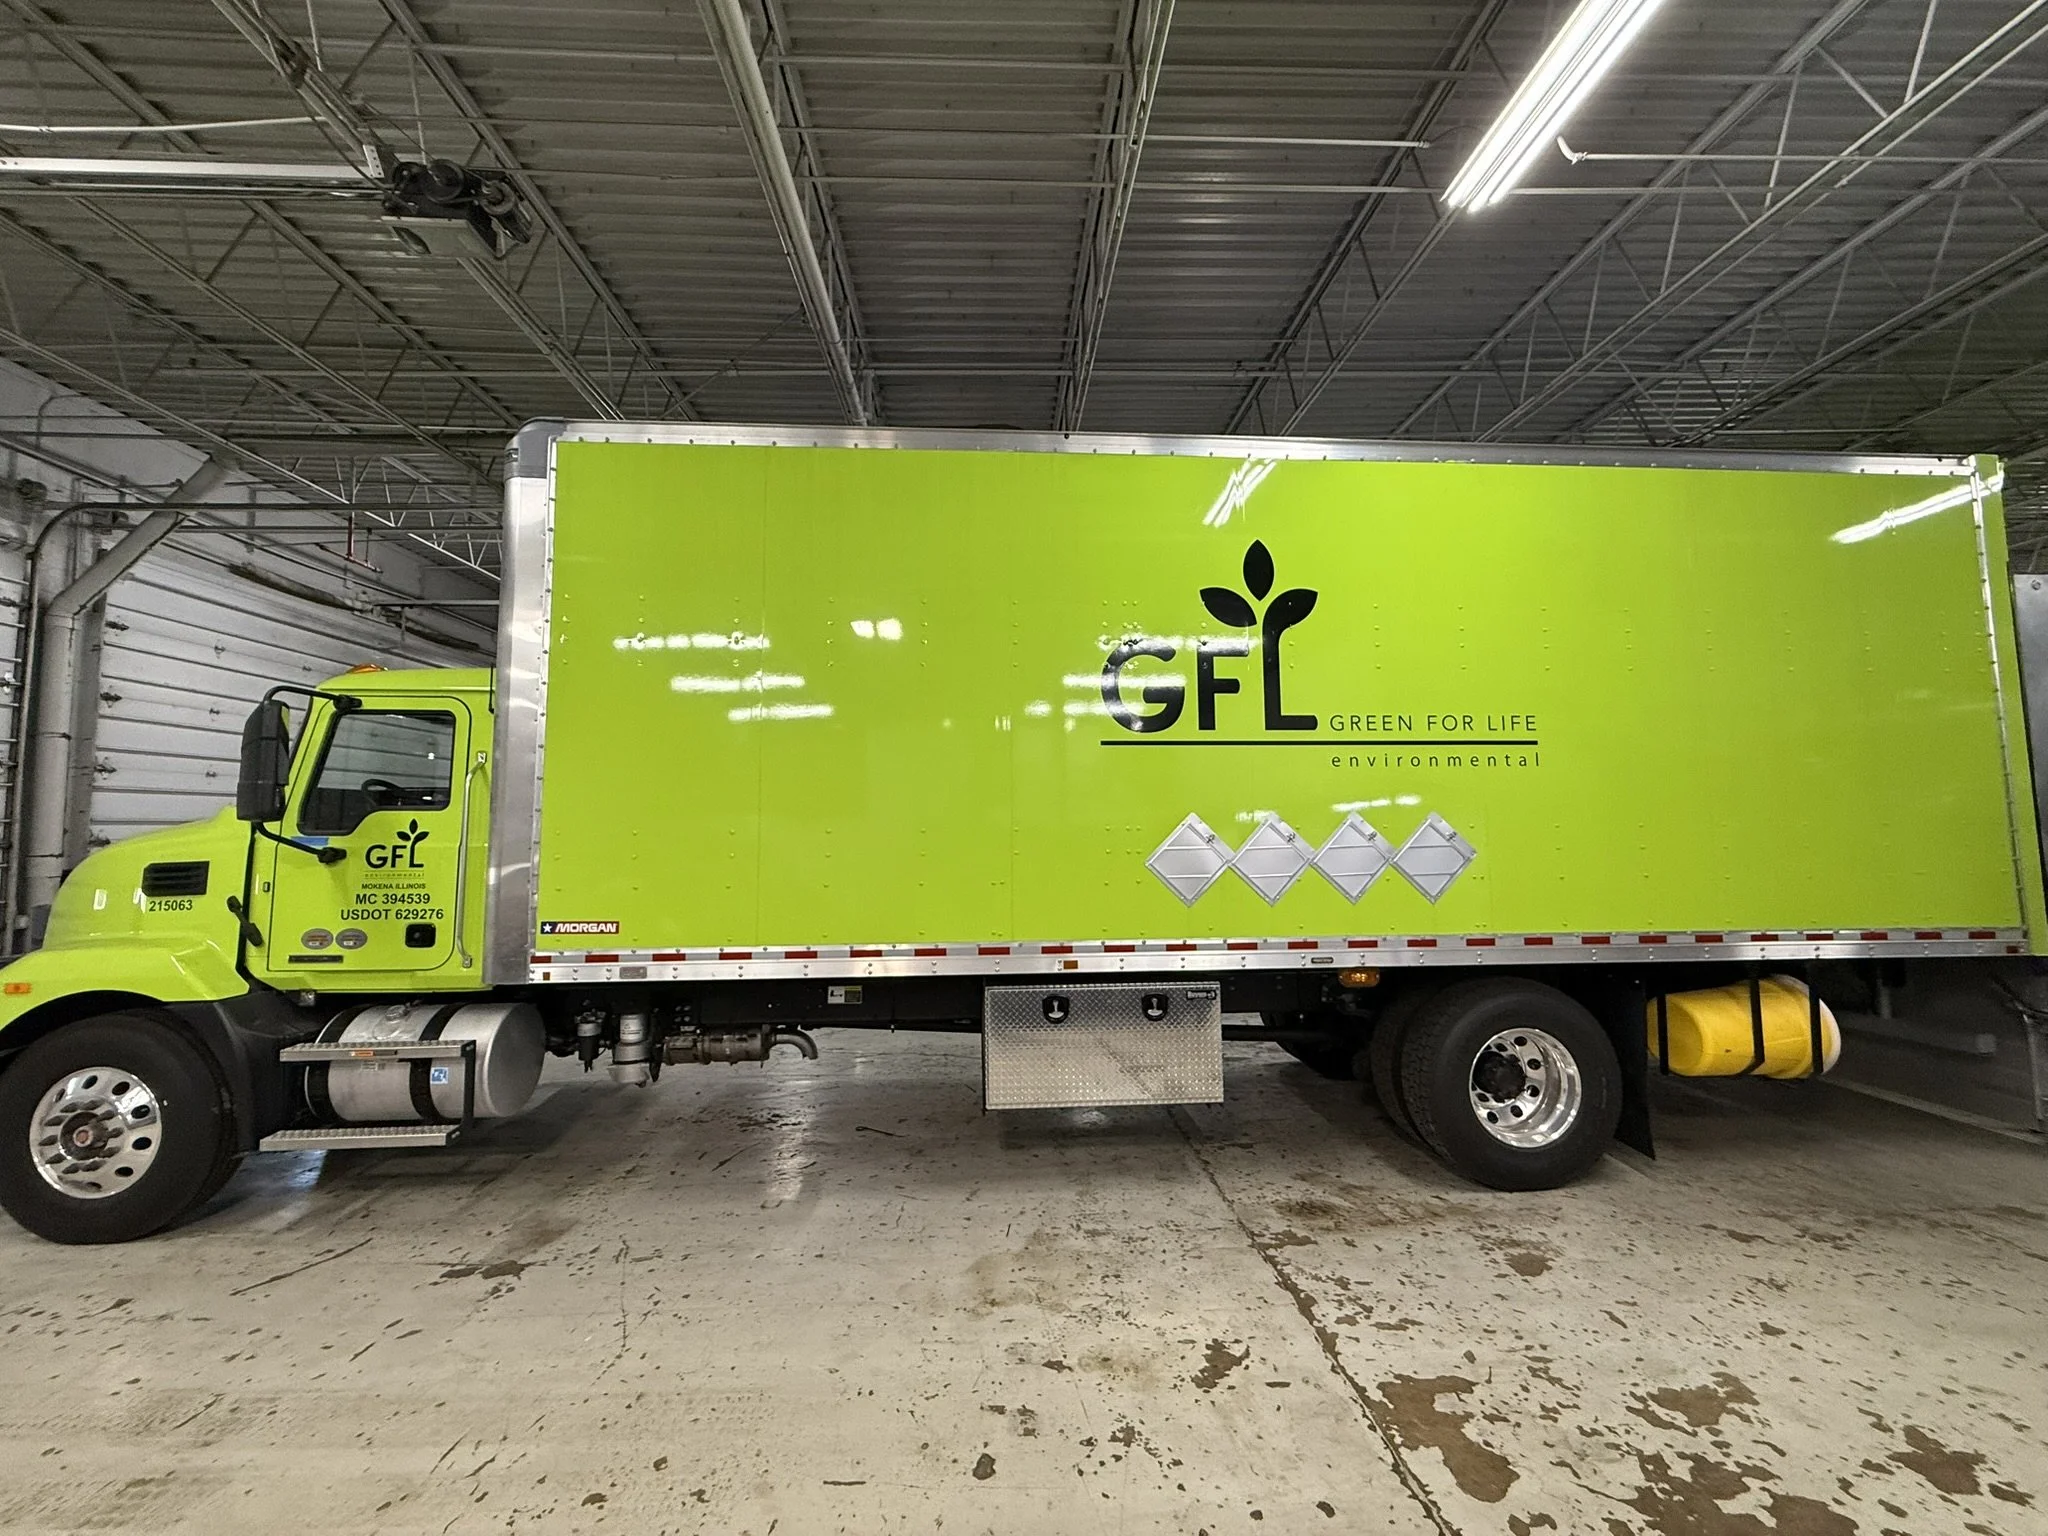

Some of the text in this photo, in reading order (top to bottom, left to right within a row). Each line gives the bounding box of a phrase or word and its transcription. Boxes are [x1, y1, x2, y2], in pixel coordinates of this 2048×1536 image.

[1101, 588, 1318, 733] GFL
[1329, 714, 1537, 732] GREEN FOR LIFE
[1331, 752, 1539, 768] environmental
[365, 831, 429, 869] GFL
[395, 882, 426, 890] ILLINOIS
[355, 893, 431, 905] MC 394539
[149, 900, 193, 912] 215063
[340, 908, 444, 921] USDOT 629276
[555, 923, 617, 933] MORGAN
